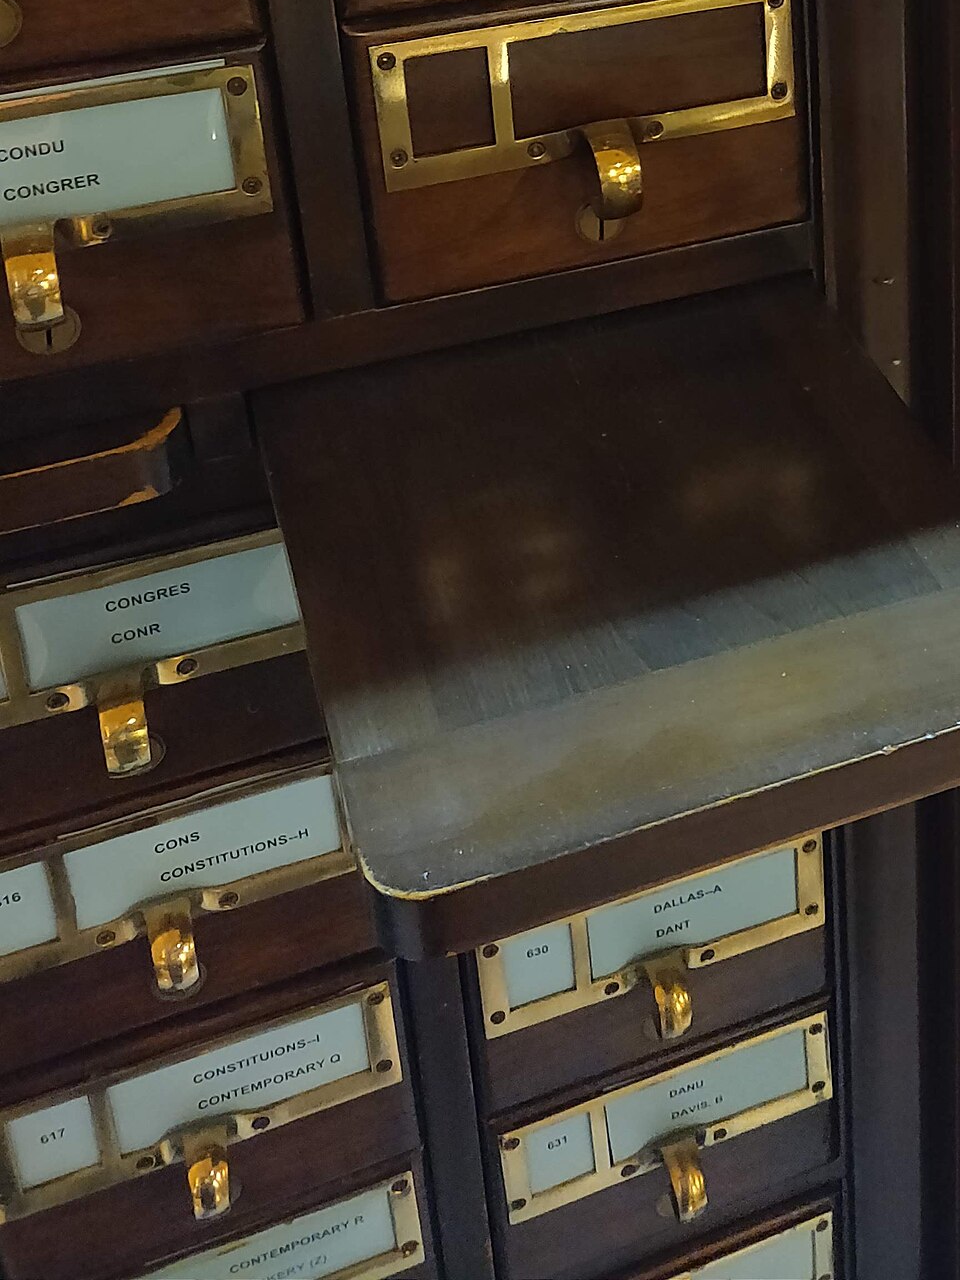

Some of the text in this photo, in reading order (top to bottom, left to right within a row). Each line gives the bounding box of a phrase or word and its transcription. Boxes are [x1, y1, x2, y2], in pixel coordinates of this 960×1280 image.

[0, 139, 64, 163] CONDU
[3, 173, 101, 201] CONGRER
[105, 582, 192, 613] CONGRES
[111, 623, 162, 645] CONR
[154, 831, 201, 855] CONS
[655, 919, 691, 940] DANT
[526, 944, 549, 959] 630
[197, 1053, 342, 1111] CONTEMPORARY Q
[669, 1079, 704, 1099] DANU
[40, 1127, 67, 1145] 617
[547, 1135, 568, 1151] 631
[229, 1215, 365, 1274] CONTEMPORARY R
